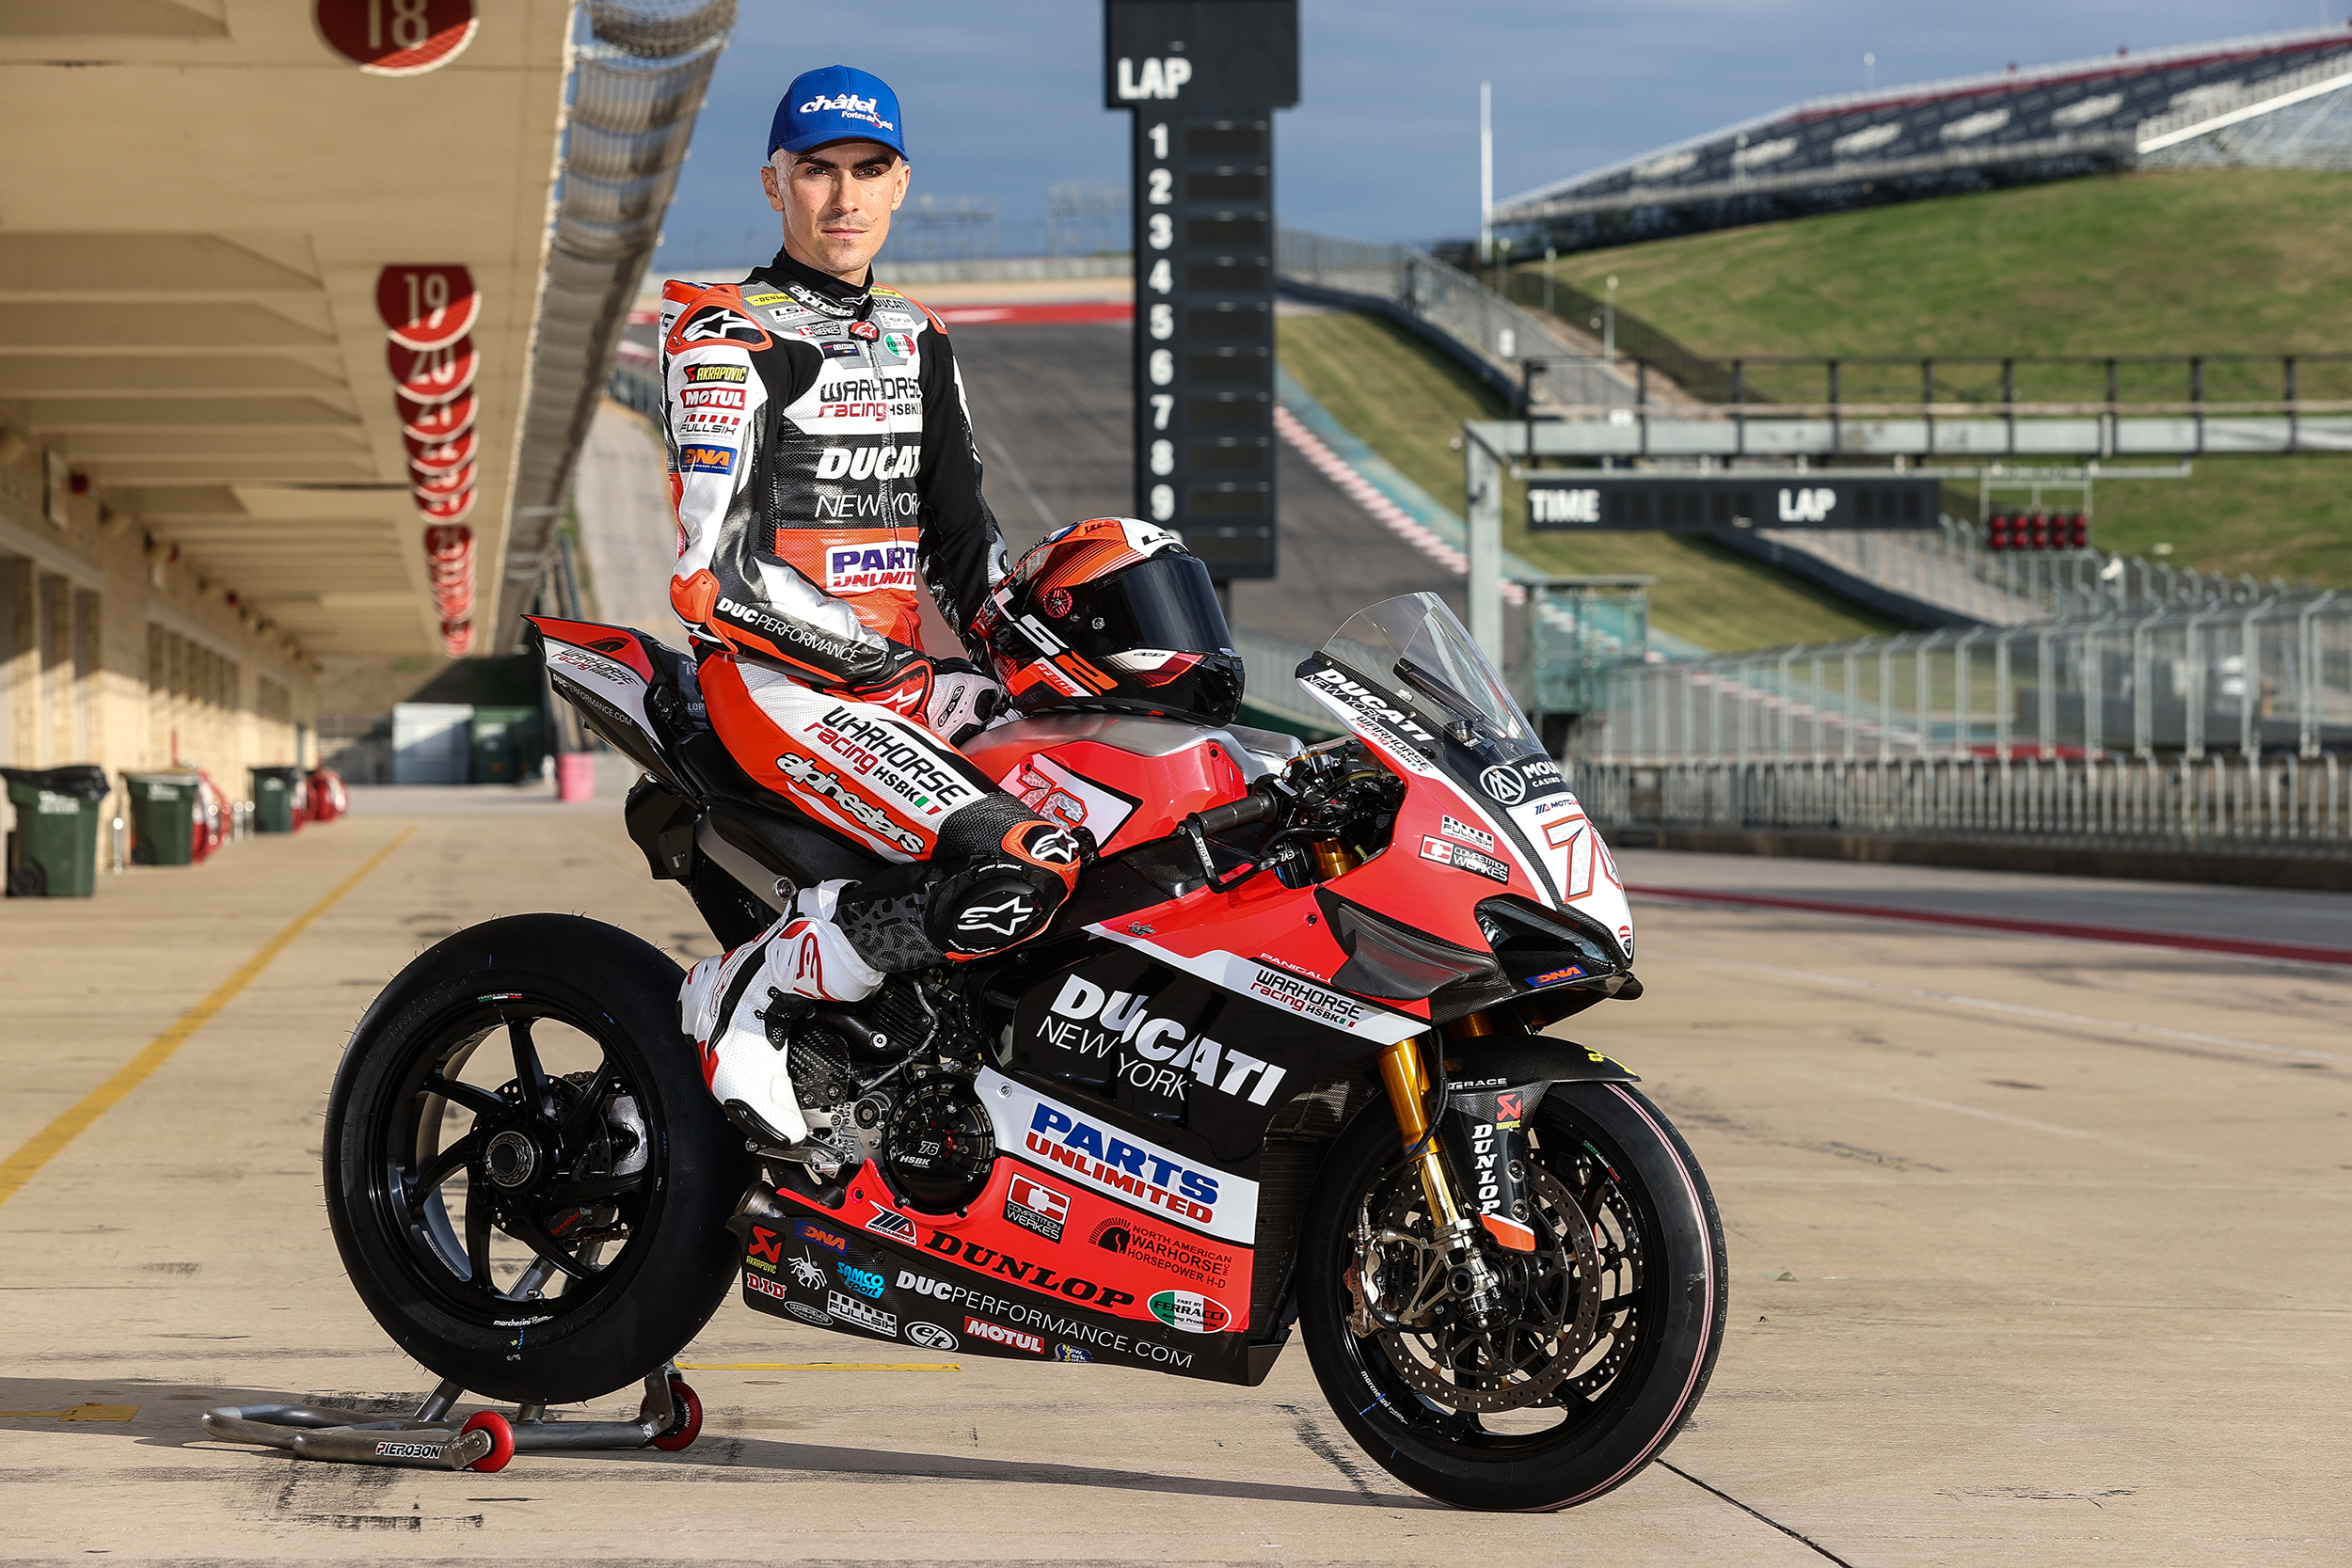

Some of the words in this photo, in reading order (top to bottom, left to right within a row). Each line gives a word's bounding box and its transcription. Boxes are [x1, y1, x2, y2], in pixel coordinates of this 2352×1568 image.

[1118, 57, 1192, 100] LAP
[800, 94, 877, 114] châtel
[1148, 122, 1168, 160] 1
[1148, 167, 1173, 205] 2
[1148, 213, 1173, 250] 3
[1148, 258, 1173, 294] 4
[404, 274, 450, 329] 19
[873, 299, 911, 310] DUCATI
[1150, 303, 1174, 341] 5
[1150, 348, 1174, 386] 6
[685, 389, 743, 407] MOTUL
[818, 403, 887, 421] racing
[1150, 393, 1174, 430] 7
[679, 423, 737, 436] FULLSIX
[685, 449, 730, 467] DNA
[1151, 438, 1174, 476] 8
[815, 494, 882, 517] NEW
[1151, 483, 1175, 521] 9
[1528, 488, 1599, 523] TIME
[1778, 487, 1836, 522] LAP
[716, 597, 861, 663] DUCPERFORMANCE
[551, 653, 592, 671] racing
[560, 649, 639, 686] WARHORSE
[1303, 673, 1347, 696] NEW
[1340, 694, 1387, 721] YORK
[1316, 668, 1436, 741] DUCATI
[1349, 718, 1390, 746] racing
[1356, 716, 1434, 770] WARHORSE
[803, 722, 878, 775] racing
[872, 766, 920, 802] HSBK
[821, 705, 971, 806] WARHORSE
[775, 752, 925, 855] alpinestars
[1193, 837, 1215, 868] SPIDER
[1443, 823, 1494, 848] FULLSIX
[1454, 847, 1508, 872] COMPETITION
[1454, 855, 1508, 882] WERKES
[1249, 982, 1306, 1012] racing
[1305, 1004, 1339, 1023] HSBK
[1256, 969, 1364, 1020] WARHORSE
[1036, 1016, 1119, 1058] NEW
[1117, 1052, 1185, 1101] YORK
[1050, 974, 1287, 1106] DUCATI
[899, 1155, 930, 1165] HSBK
[918, 1140, 940, 1156] 76
[1031, 1102, 1218, 1205] PARTS
[1025, 1132, 1214, 1224] UNLIMITED
[1471, 1124, 1502, 1214] DUNLOP
[551, 1212, 580, 1237] brembo
[1007, 1203, 1061, 1230] COMPETITION
[1007, 1209, 1059, 1240] WERKES
[803, 1226, 846, 1251] DNA
[1132, 1233, 1224, 1275] WARHORSE
[1222, 1262, 1231, 1276] INC
[1133, 1225, 1170, 1243] NORTH
[1172, 1240, 1232, 1264] AMERICAN
[837, 1261, 884, 1288] SAMCO
[924, 1229, 1136, 1309] DUNLOP
[1127, 1247, 1204, 1283] HORSEPOWER
[1206, 1275, 1227, 1289] H-D
[848, 1279, 880, 1297] sport
[493, 1318, 531, 1326] marchesini
[829, 1301, 897, 1332] FULLSIX
[896, 1270, 1193, 1369] DUCPERFORMANCE.COM
[1152, 1300, 1225, 1322] FERRACCI
[1162, 1312, 1185, 1323] Racing
[1185, 1318, 1217, 1327] Products
[966, 1320, 1042, 1353] MOTUL
[375, 1442, 442, 1459] PIEROBON
